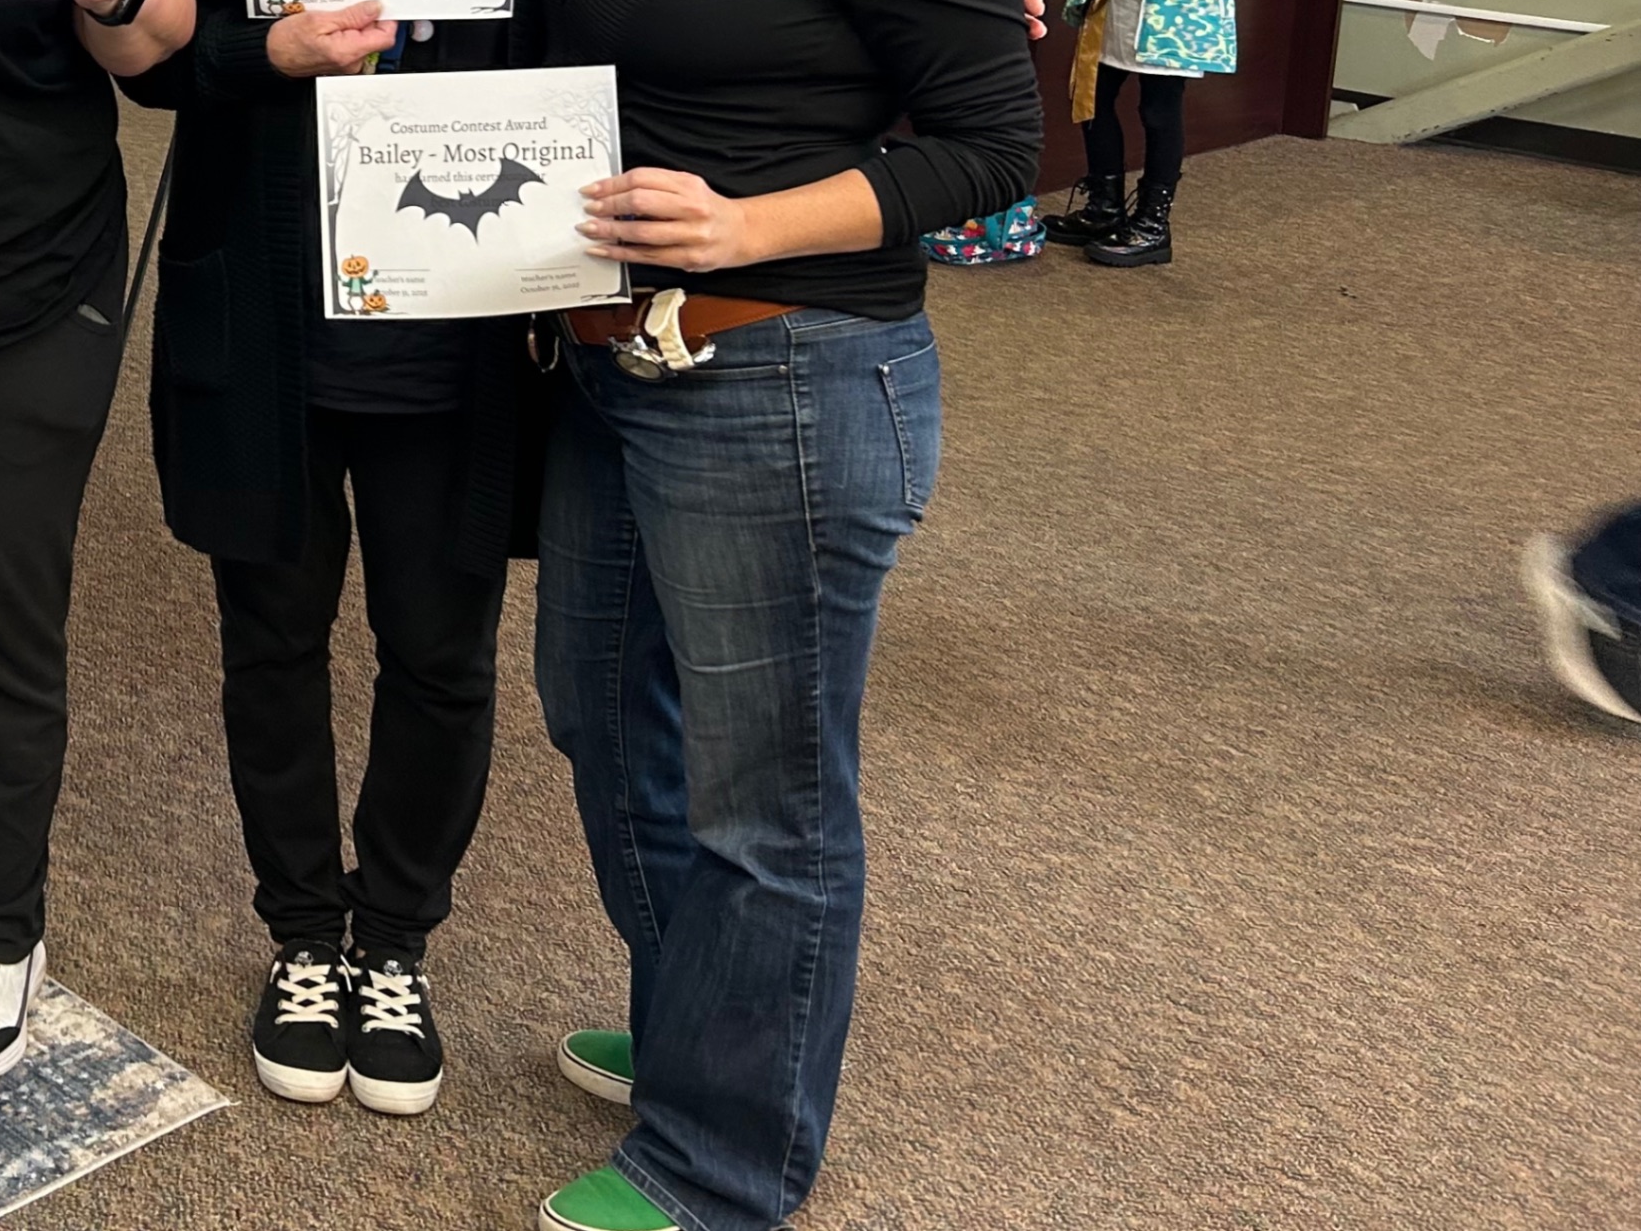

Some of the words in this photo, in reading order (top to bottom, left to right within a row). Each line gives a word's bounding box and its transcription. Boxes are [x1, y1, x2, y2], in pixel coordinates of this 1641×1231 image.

[390, 122, 448, 134] Costume
[451, 120, 501, 132] Contest
[505, 117, 547, 131] Award
[359, 143, 424, 169] Bailey
[443, 144, 496, 162] Most
[502, 138, 595, 166] Original
[420, 172, 451, 183] arned
[453, 171, 473, 182] this
